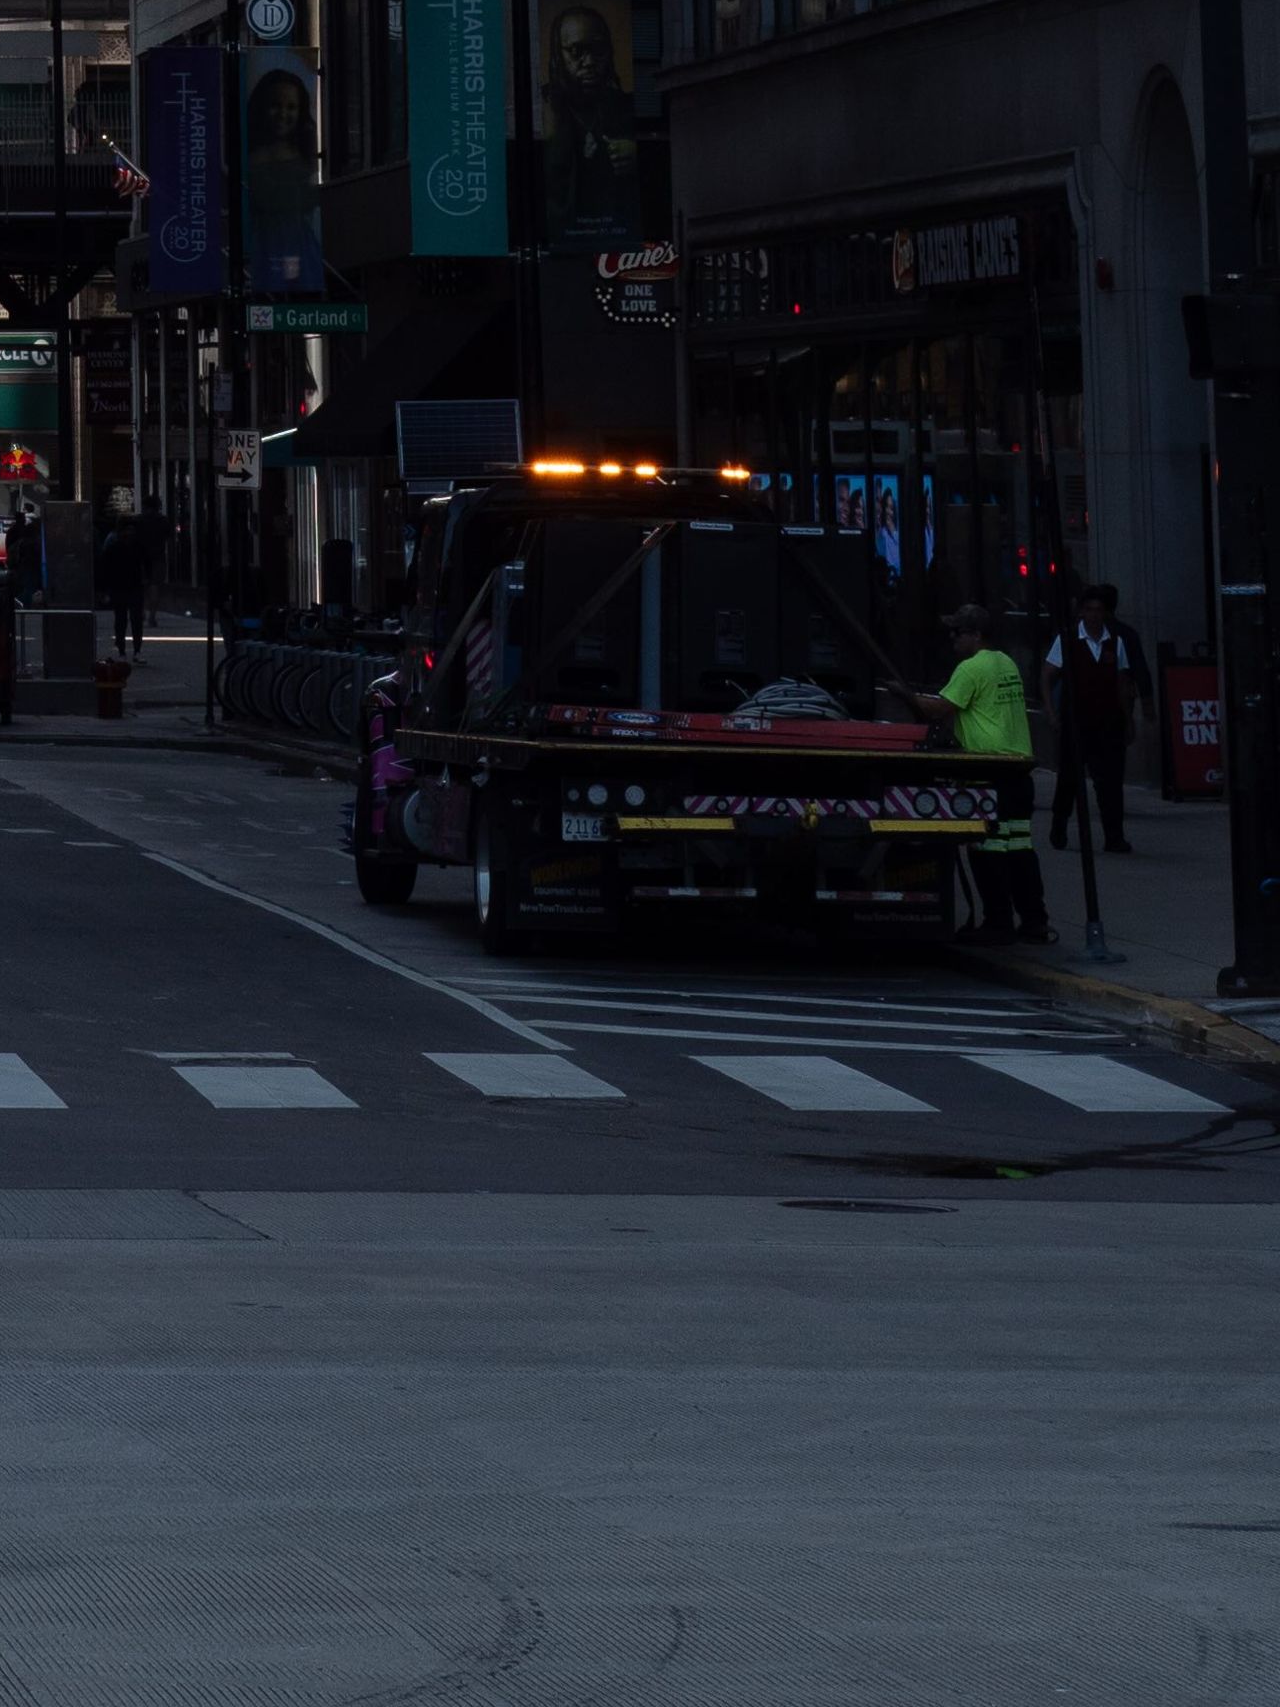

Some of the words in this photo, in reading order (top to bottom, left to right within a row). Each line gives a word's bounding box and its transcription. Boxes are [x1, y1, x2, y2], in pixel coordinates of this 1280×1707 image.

[448, 21, 459, 113] MILLENNIUM
[188, 97, 207, 168] HARRIS
[449, 118, 461, 156] PARK
[465, 98, 488, 204] THEATER
[445, 168, 465, 200] 20
[189, 170, 208, 254] THEATER
[174, 226, 189, 251] 20
[598, 239, 680, 279] Cane's
[621, 299, 657, 312] LOVE
[624, 284, 654, 297] ONE
[286, 308, 348, 326] Garland
